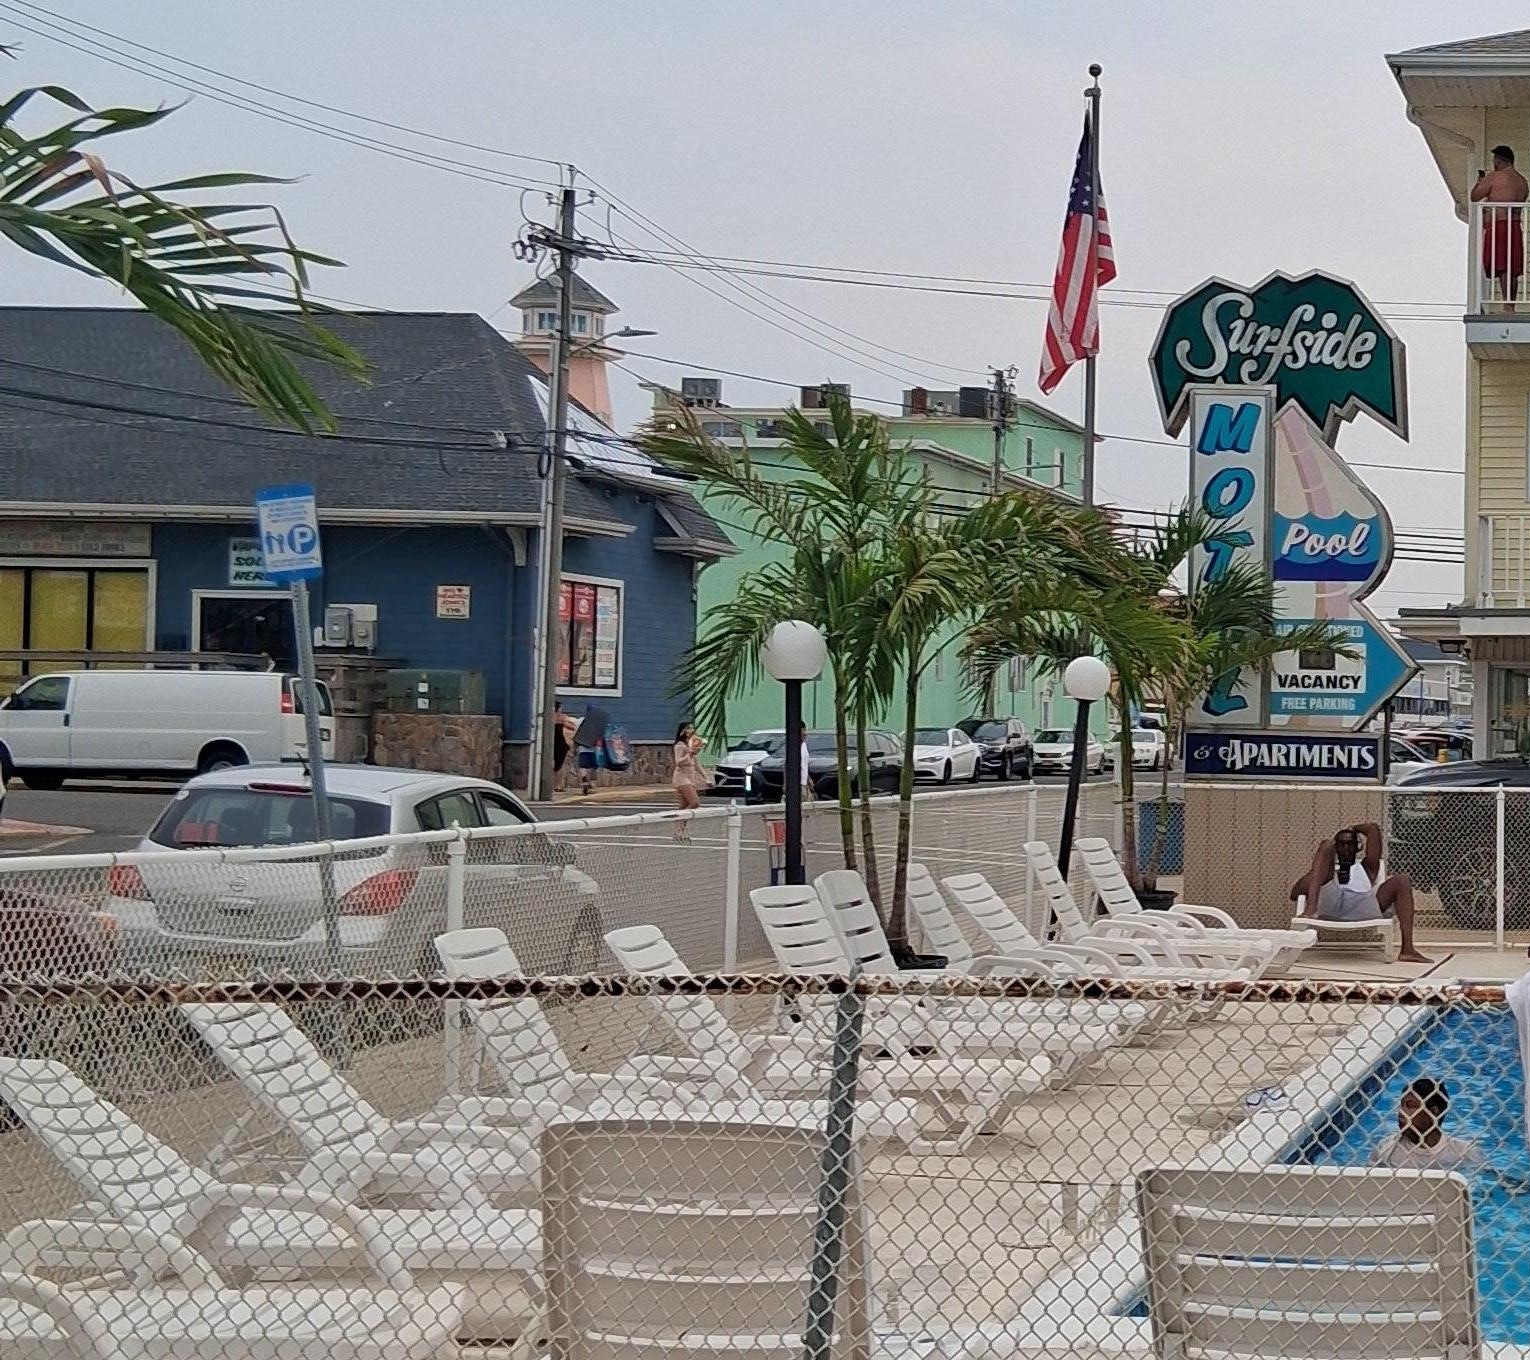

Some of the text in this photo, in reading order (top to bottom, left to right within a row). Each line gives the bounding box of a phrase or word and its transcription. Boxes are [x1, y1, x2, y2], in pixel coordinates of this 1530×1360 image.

[1175, 291, 1378, 385] Surfside
[1281, 522, 1371, 556] Pool
[1197, 402, 1262, 716] MOTL
[1277, 673, 1363, 690] VACANCY
[1281, 696, 1356, 711] FREE PARKING
[1218, 739, 1376, 771] APARTMENTS
